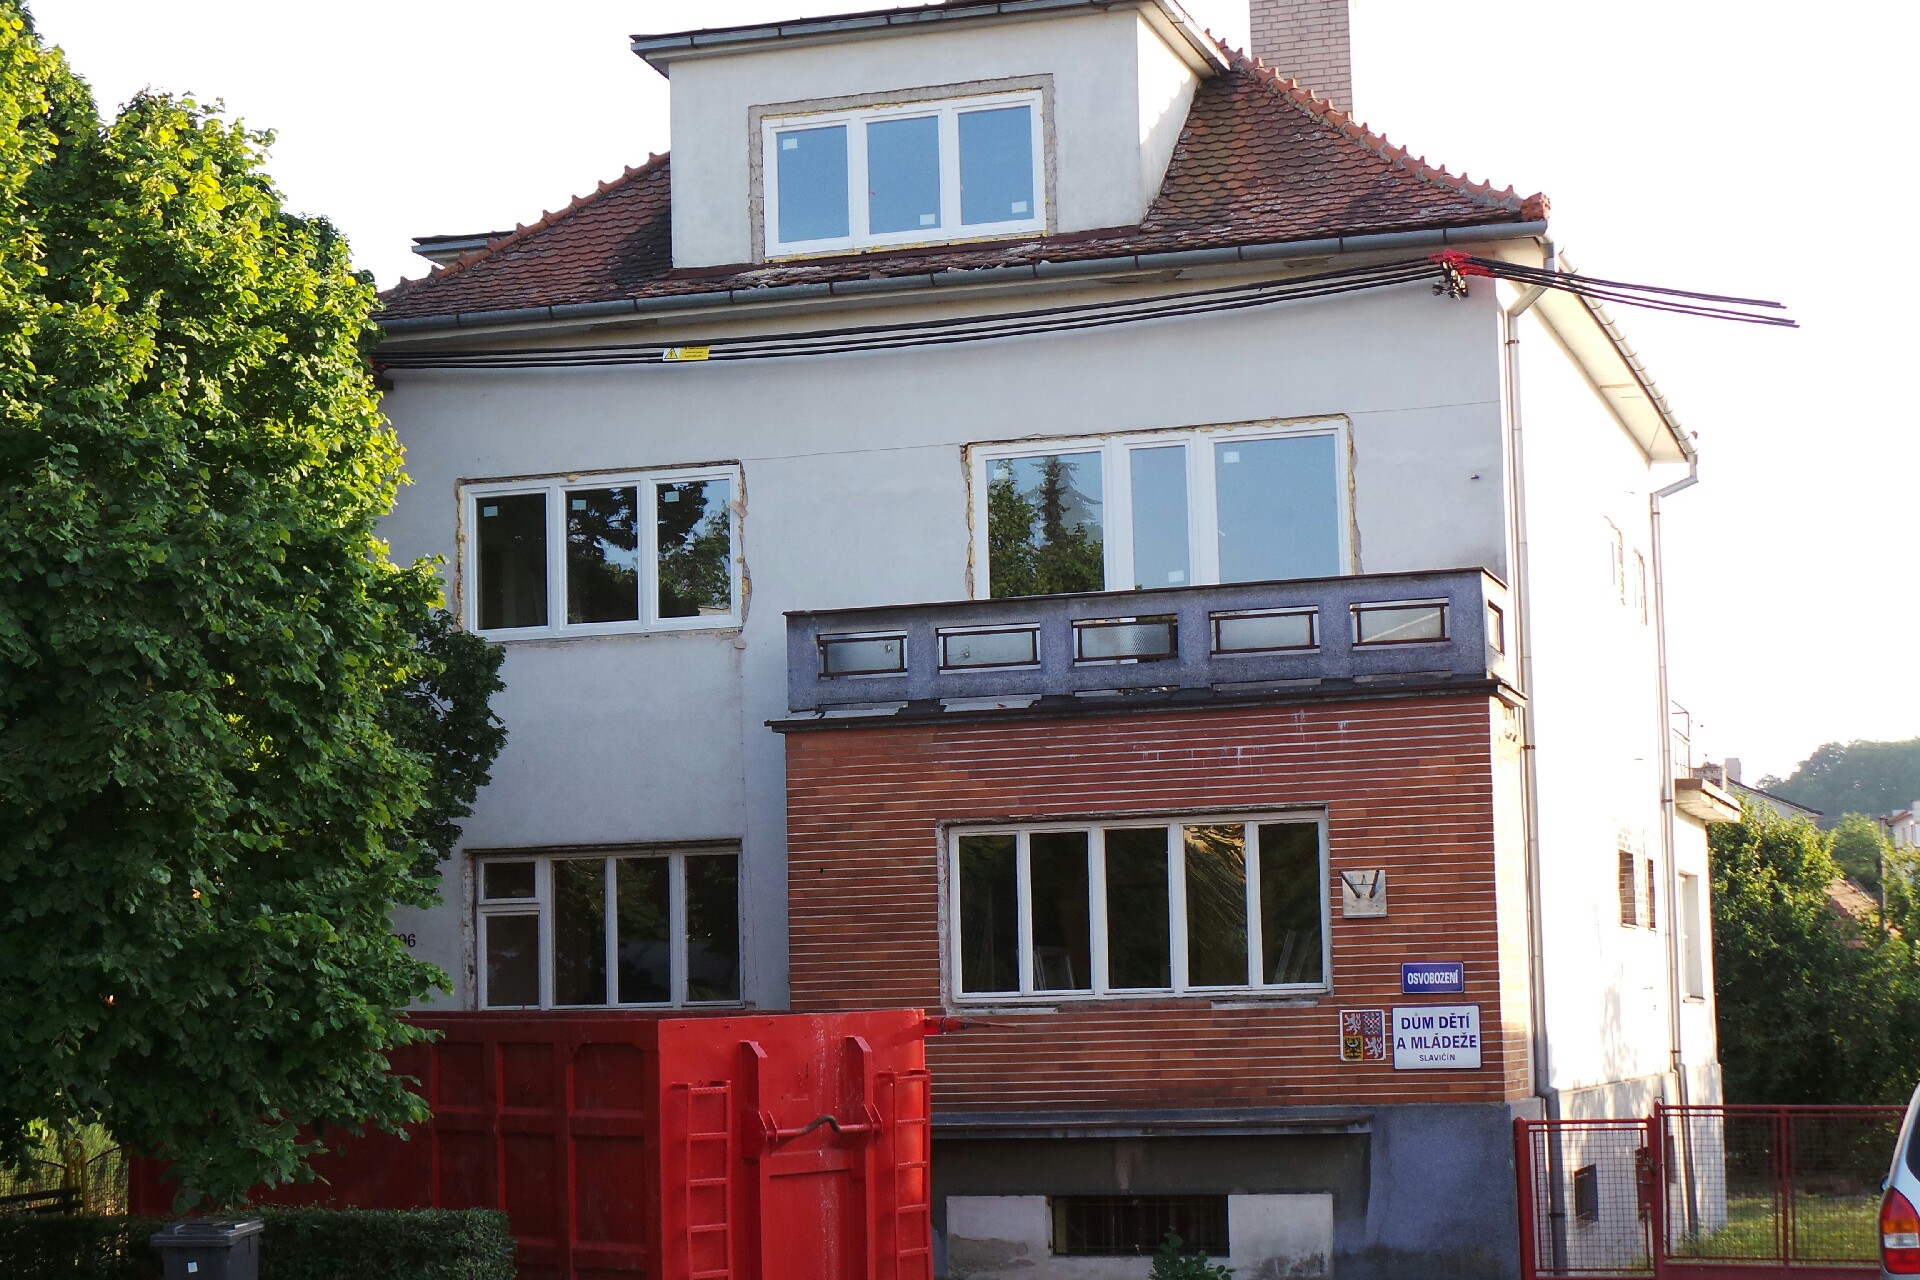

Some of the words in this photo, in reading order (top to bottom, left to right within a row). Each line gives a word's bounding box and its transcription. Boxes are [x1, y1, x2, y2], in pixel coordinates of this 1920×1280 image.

[391, 933, 416, 948] 96
[1407, 970, 1458, 985] OSVOBOZENÍ
[1401, 1013, 1433, 1030] DŮM
[1438, 1012, 1470, 1029] DĚTÍ
[1396, 1037, 1406, 1050] A
[1411, 1032, 1477, 1049] MLÁDEŽE
